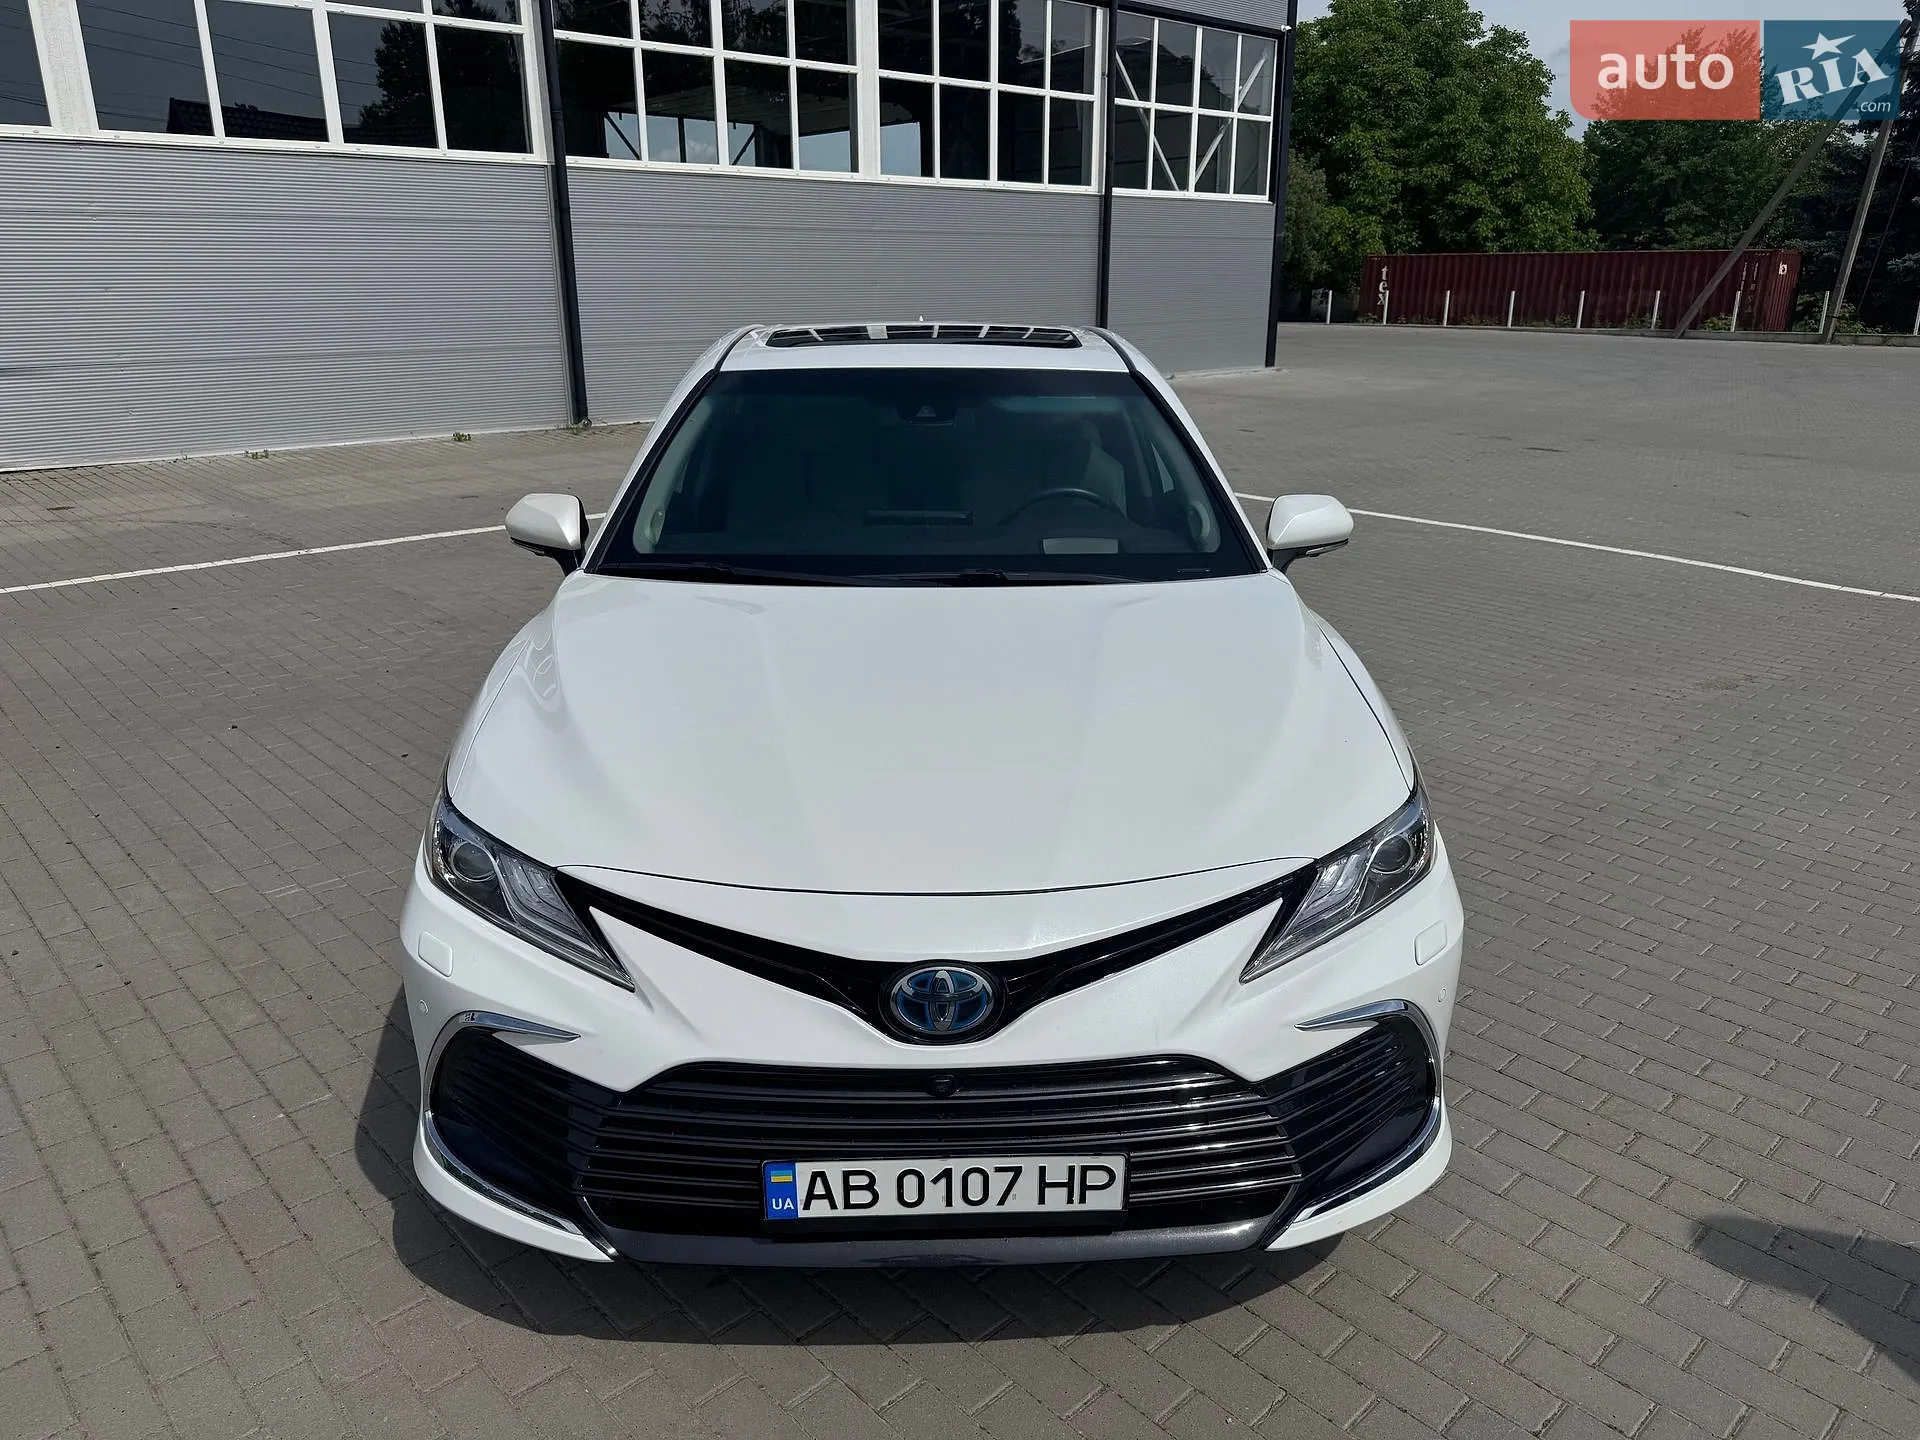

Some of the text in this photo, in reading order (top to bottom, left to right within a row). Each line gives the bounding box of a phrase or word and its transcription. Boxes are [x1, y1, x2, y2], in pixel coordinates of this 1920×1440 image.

[802, 1164, 1117, 1210] AB 0107 HP
[772, 1198, 795, 1210] UA
